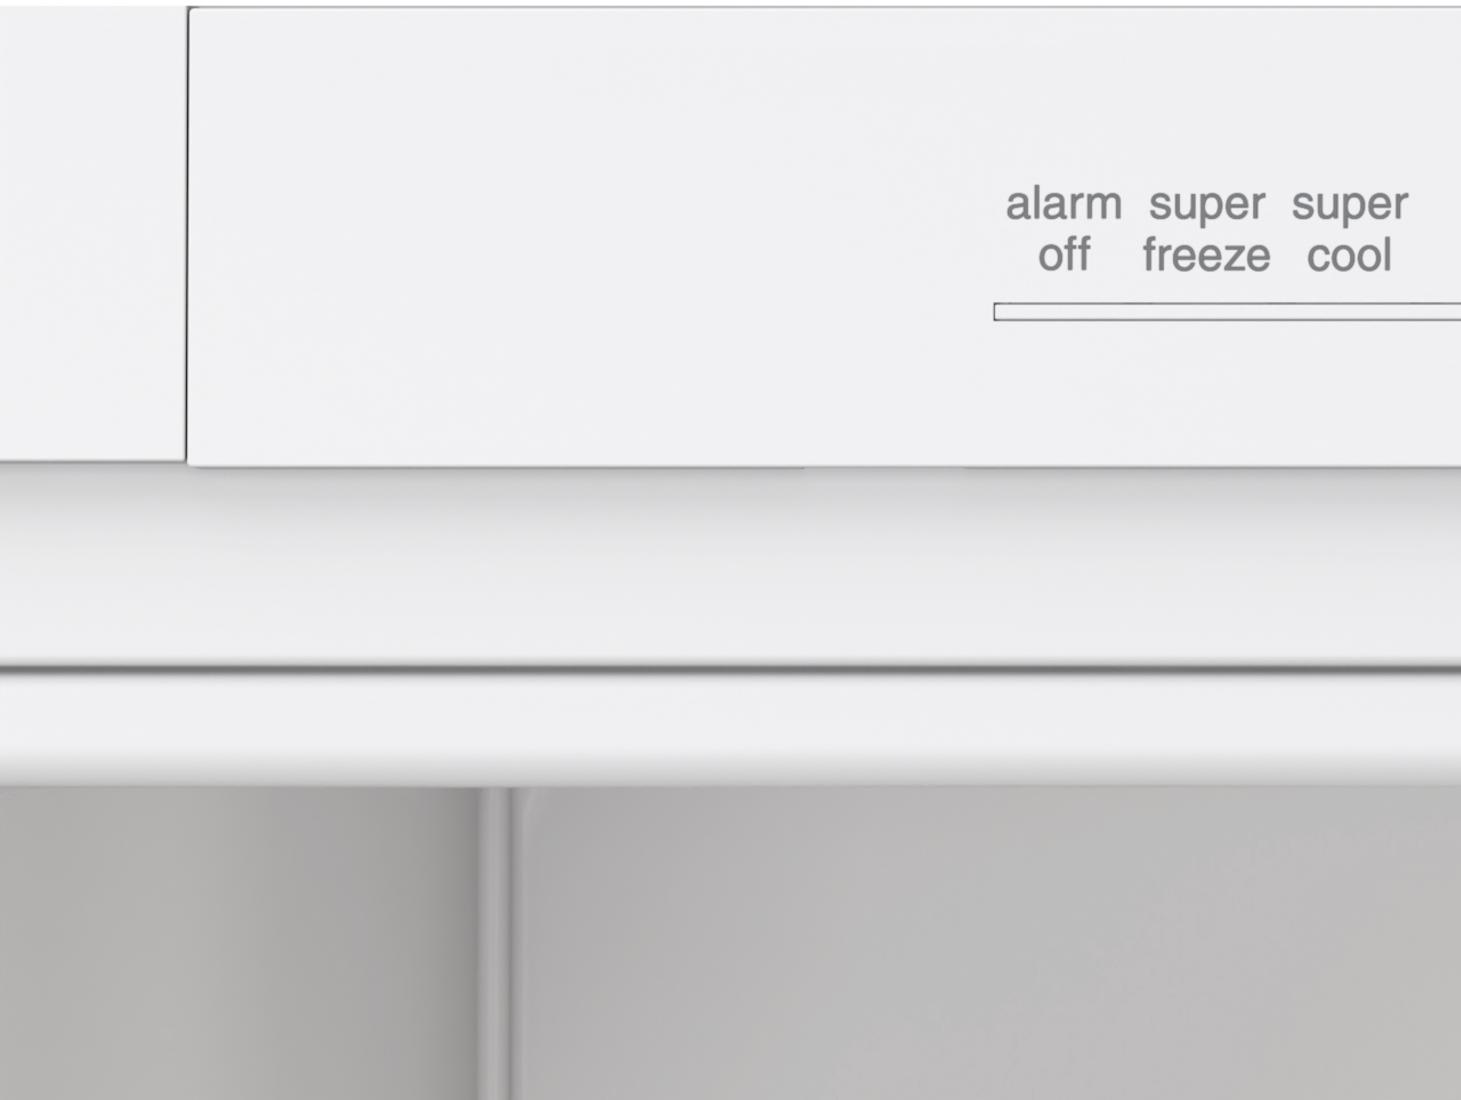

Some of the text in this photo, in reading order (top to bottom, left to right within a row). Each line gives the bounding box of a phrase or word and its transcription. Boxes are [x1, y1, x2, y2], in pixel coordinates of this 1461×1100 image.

[1006, 183, 1122, 221] alarm
[1149, 192, 1267, 230] super
[1292, 192, 1410, 230] super
[1038, 234, 1092, 272] off
[1142, 235, 1271, 273] freeze
[1307, 235, 1391, 273] cool
